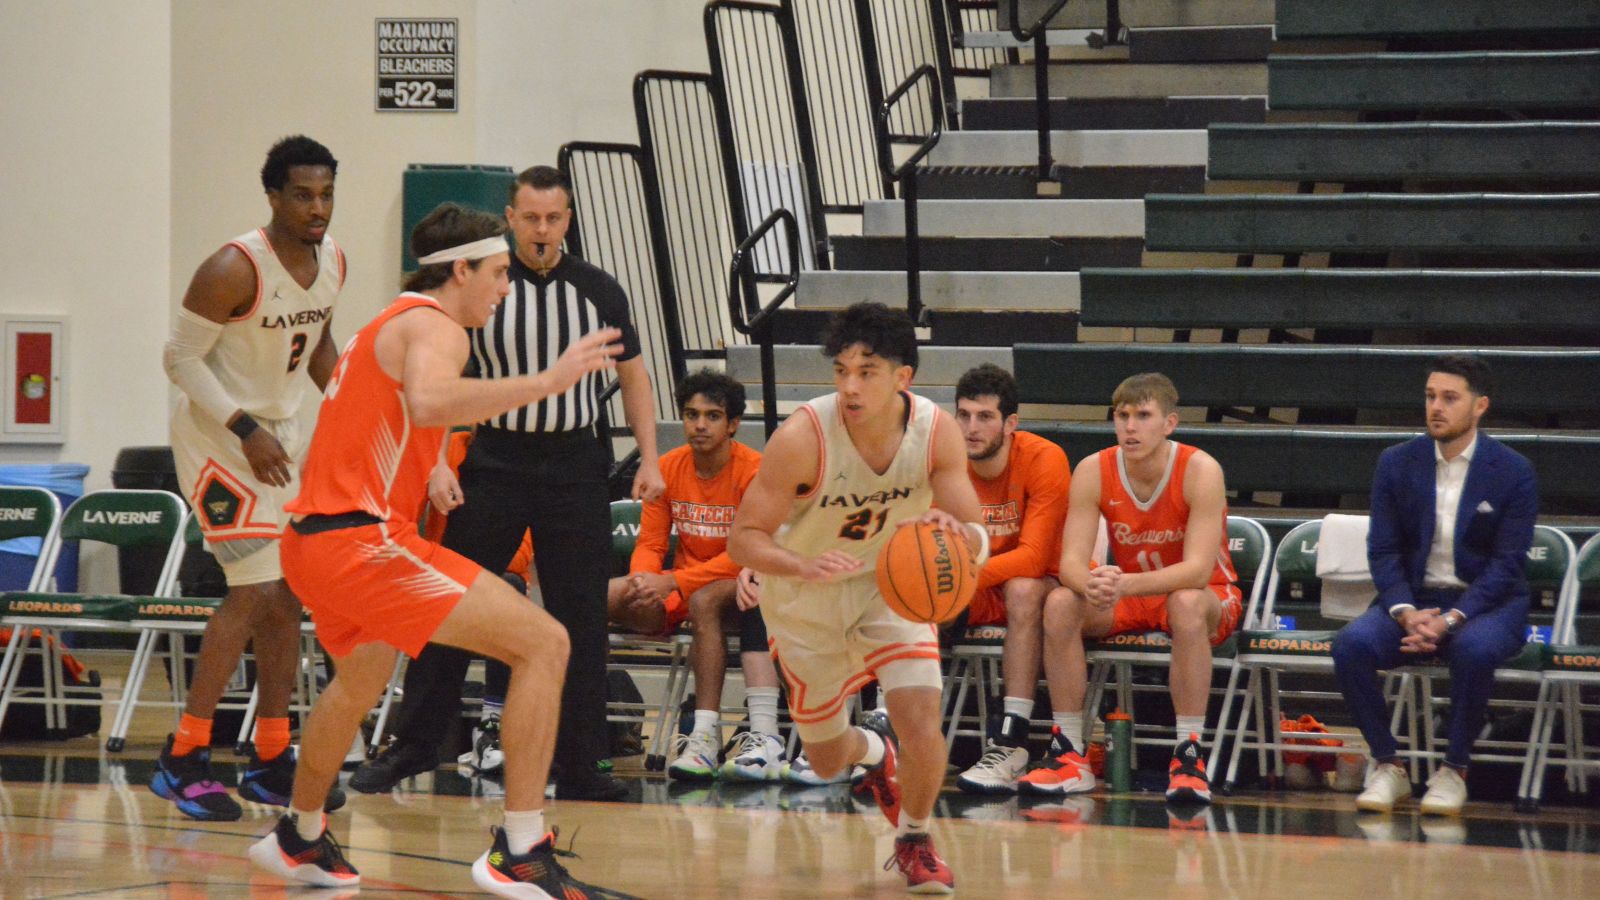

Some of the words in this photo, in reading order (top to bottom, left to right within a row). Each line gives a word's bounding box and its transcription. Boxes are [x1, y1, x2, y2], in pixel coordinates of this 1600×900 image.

[379, 22, 454, 38] MAXIMUM
[380, 38, 453, 53] OCCUPANCY
[380, 58, 454, 73] BLEACHERS
[379, 87, 394, 97] PER
[394, 81, 437, 107] 522
[437, 88, 454, 98] SIDE
[287, 331, 308, 375] 2
[0, 507, 37, 521] ERNE
[838, 507, 891, 541] 21
[1112, 521, 1185, 545] Beavers
[9, 601, 83, 614] LEOPARDS
[138, 604, 215, 617] LEOPARDS
[1250, 638, 1332, 651] LEOPARDS
